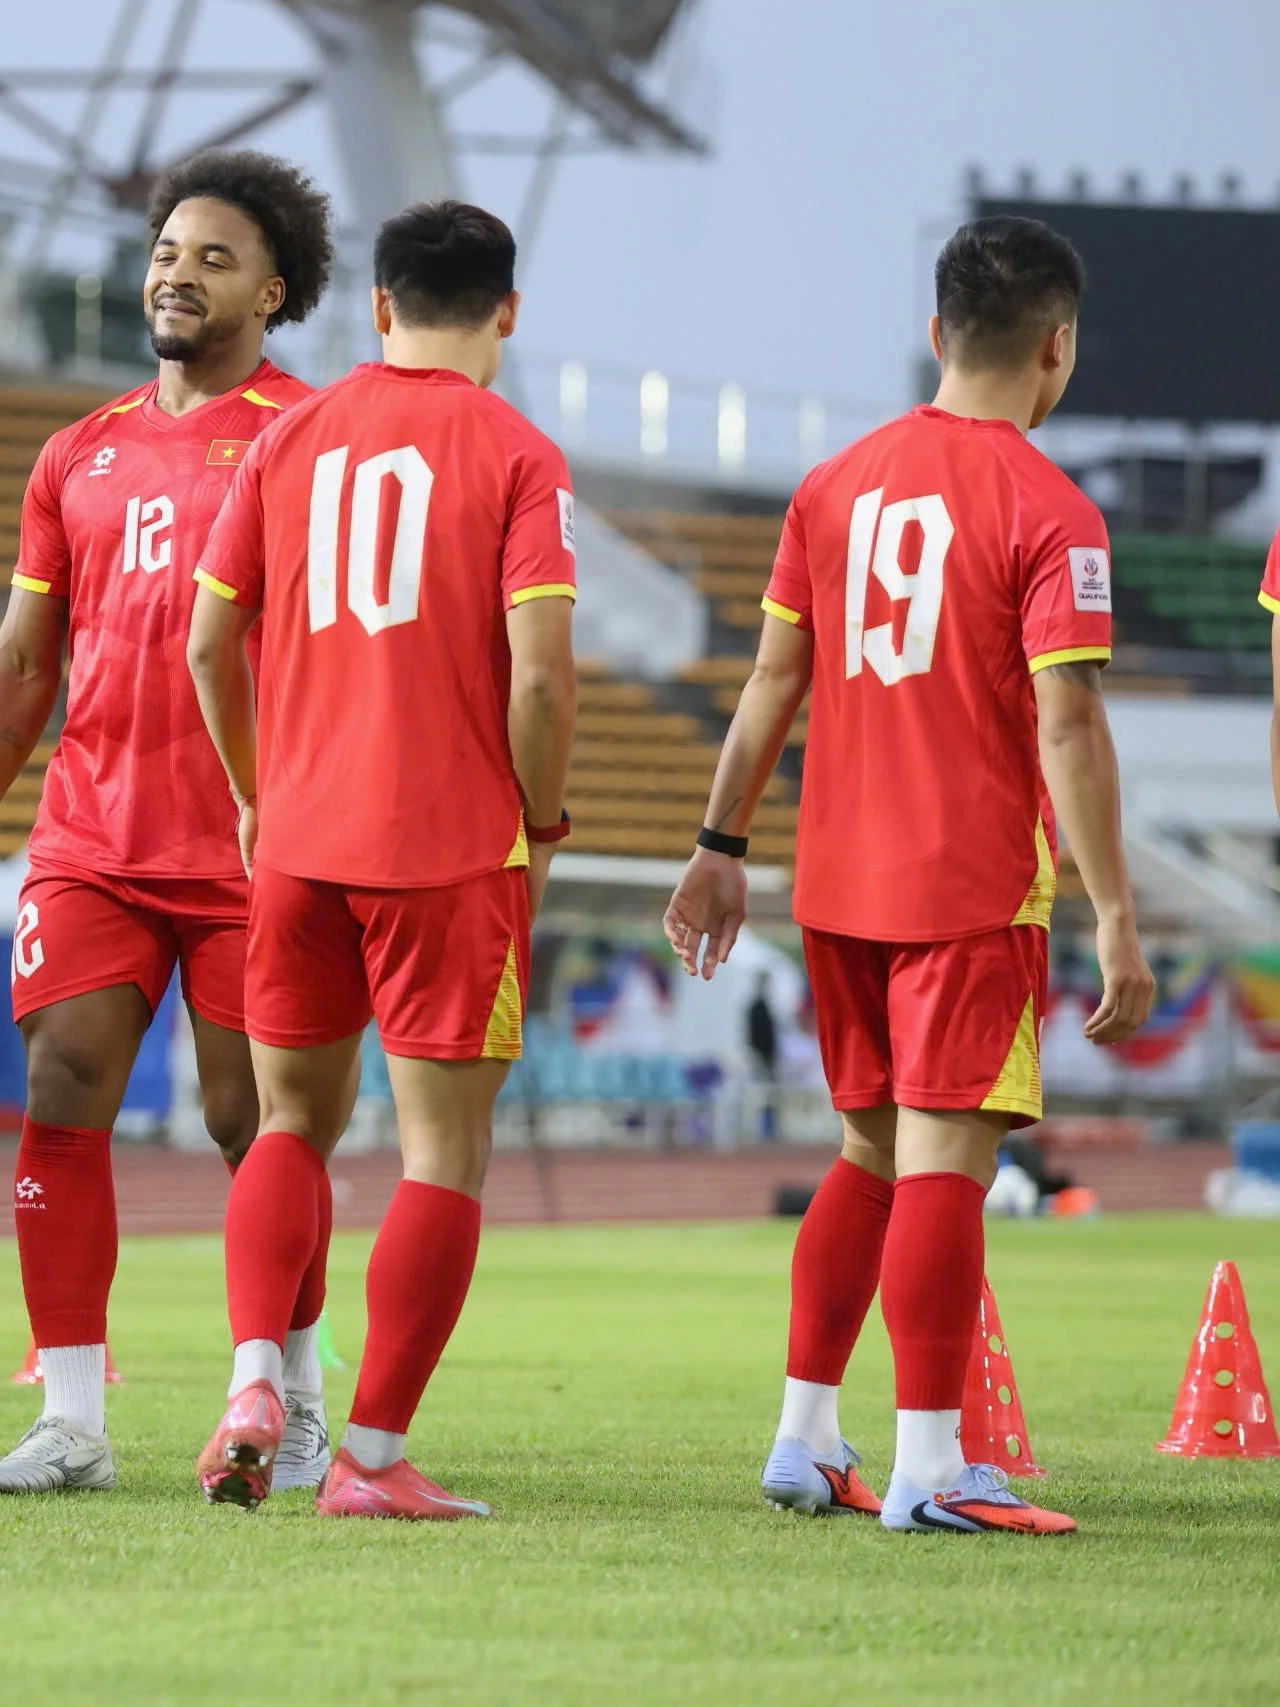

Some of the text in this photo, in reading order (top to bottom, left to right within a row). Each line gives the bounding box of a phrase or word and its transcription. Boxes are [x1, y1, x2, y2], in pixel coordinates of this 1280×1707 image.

[123, 495, 174, 574] 12
[308, 444, 435, 637] 10
[845, 486, 955, 687] 19
